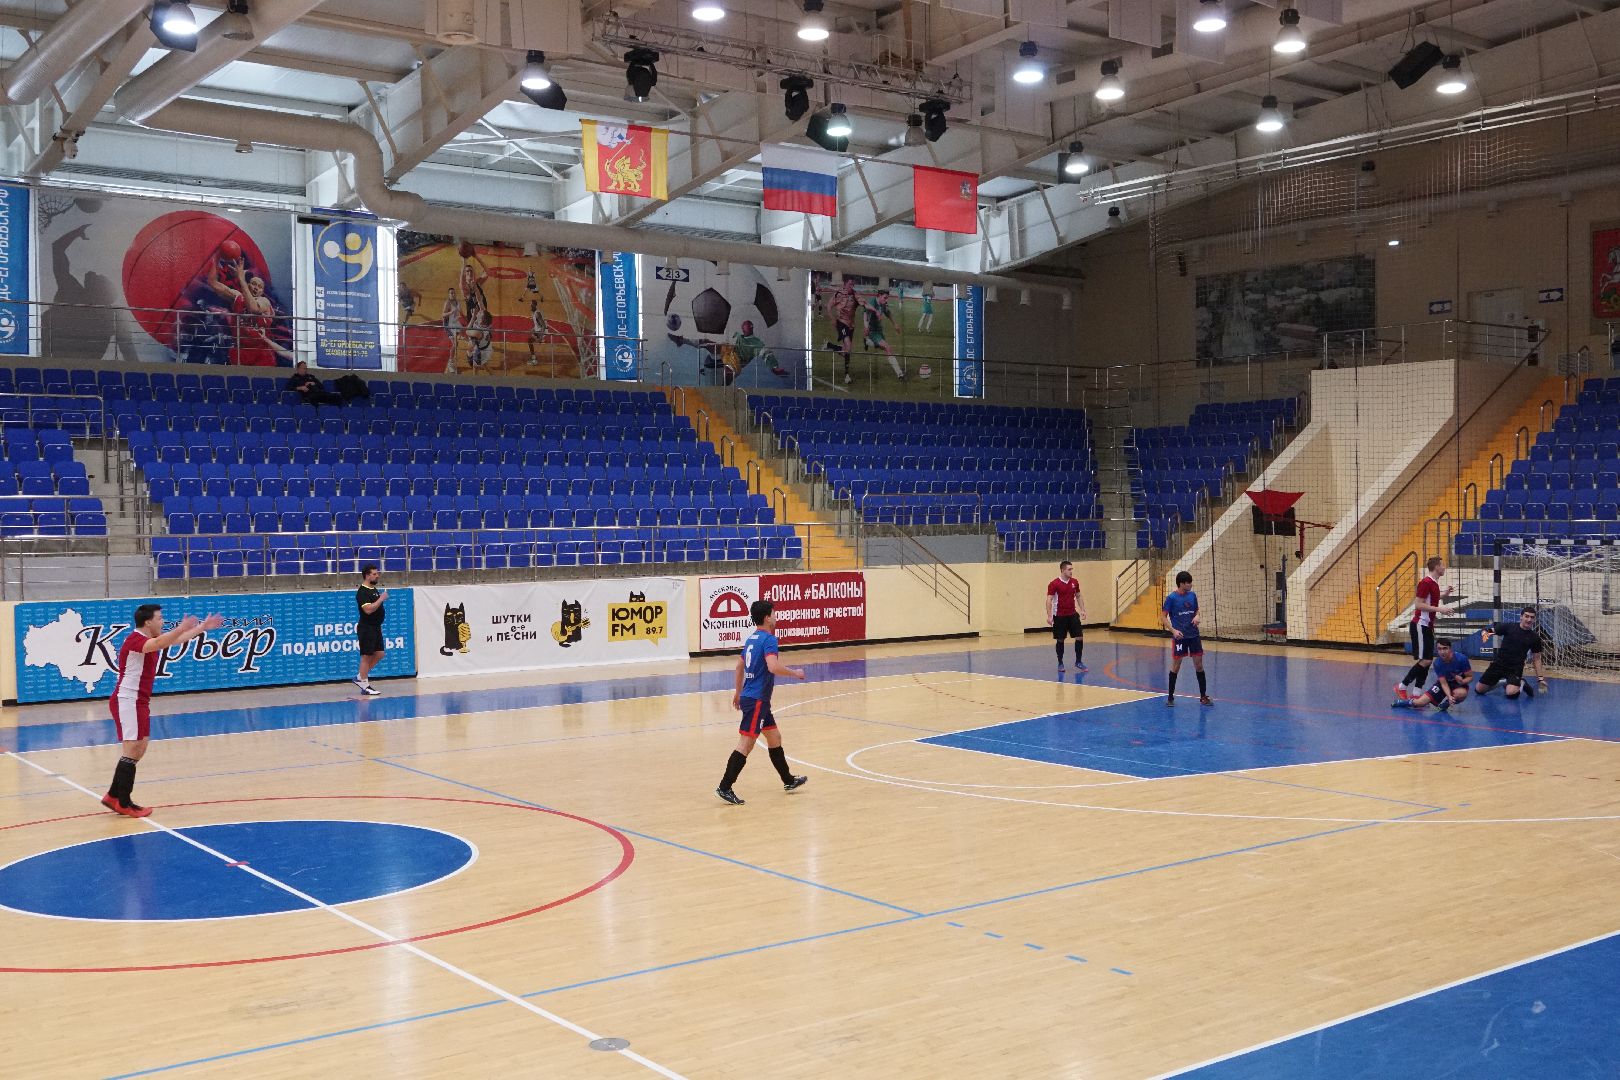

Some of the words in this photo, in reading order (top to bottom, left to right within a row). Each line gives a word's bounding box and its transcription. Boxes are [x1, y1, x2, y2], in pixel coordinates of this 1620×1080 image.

[665, 269, 672, 278] 2
[674, 270, 681, 279] 3
[763, 584, 802, 602] #ОКНА
[803, 581, 863, 600] #БАЛКОНЫ
[611, 605, 664, 624] ЮМОР
[823, 602, 864, 619] качество!
[491, 613, 532, 625] ШУТКИ
[611, 622, 636, 637] FM
[645, 626, 664, 635] 89.7
[282, 636, 404, 656] ПОДМОСКЬЯ
[486, 635, 493, 643] и
[75, 624, 277, 678] Крьер
[1175, 643, 1183, 652] 14
[745, 644, 754, 669] 6
